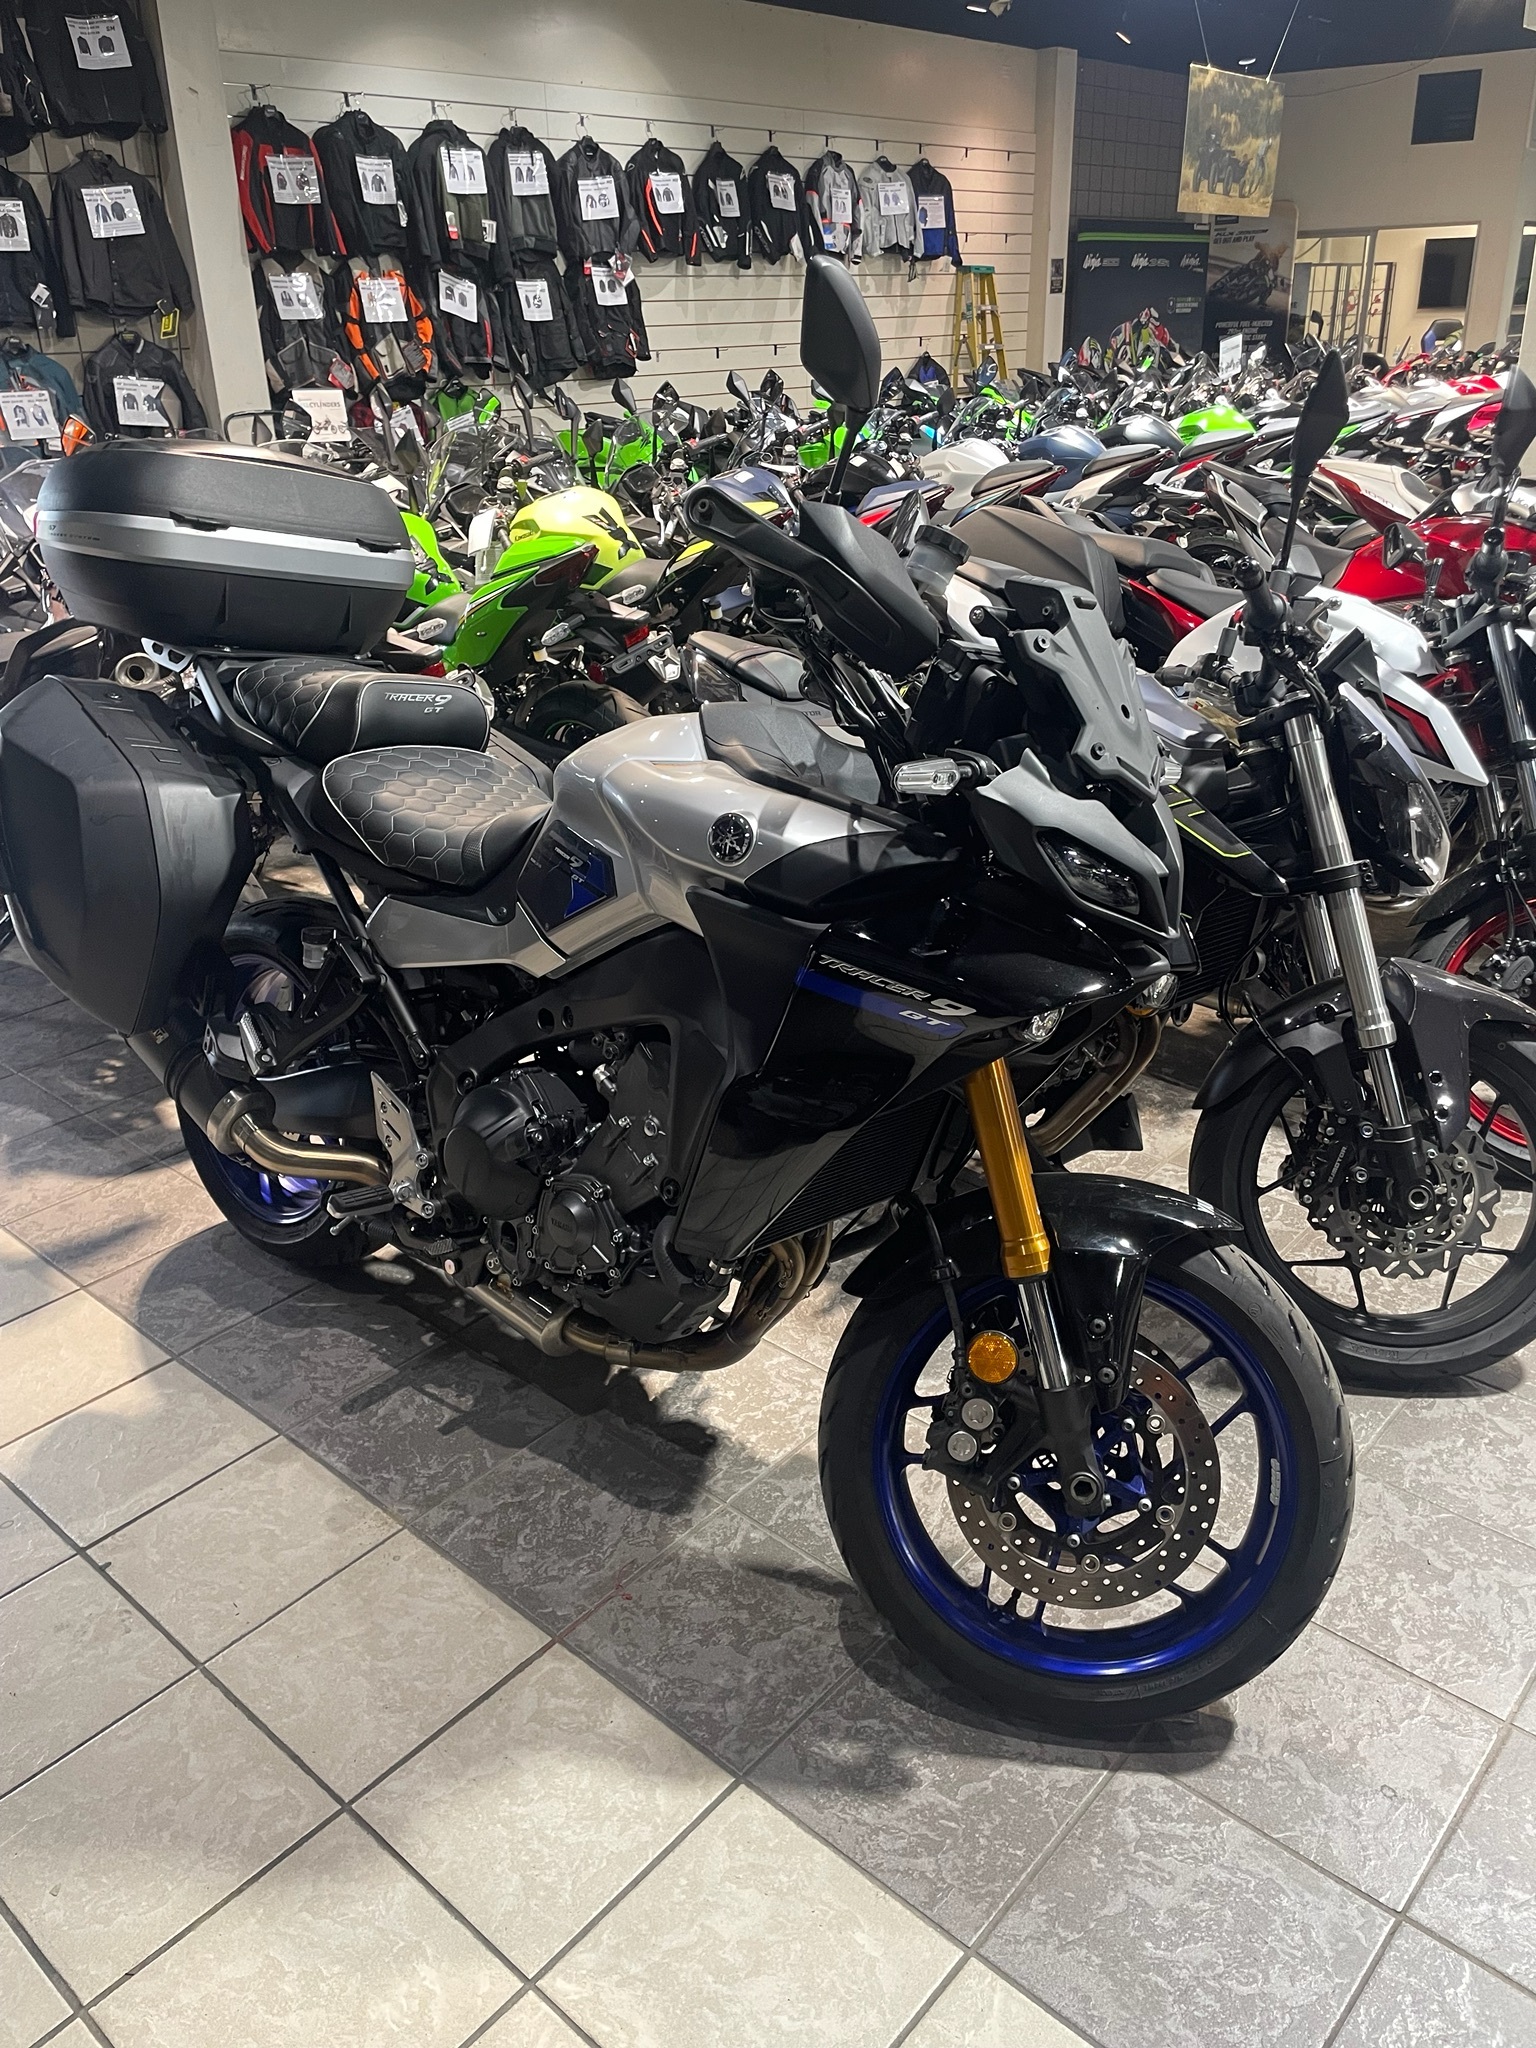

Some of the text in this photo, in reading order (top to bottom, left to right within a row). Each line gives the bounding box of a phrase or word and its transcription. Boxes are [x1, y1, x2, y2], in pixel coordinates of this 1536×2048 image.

[384, 692, 453, 706] TRACER 9
[568, 855, 584, 868] 9
[571, 874, 585, 883] GT
[818, 954, 977, 1017] TRACER 9
[898, 1010, 951, 1026] GT
